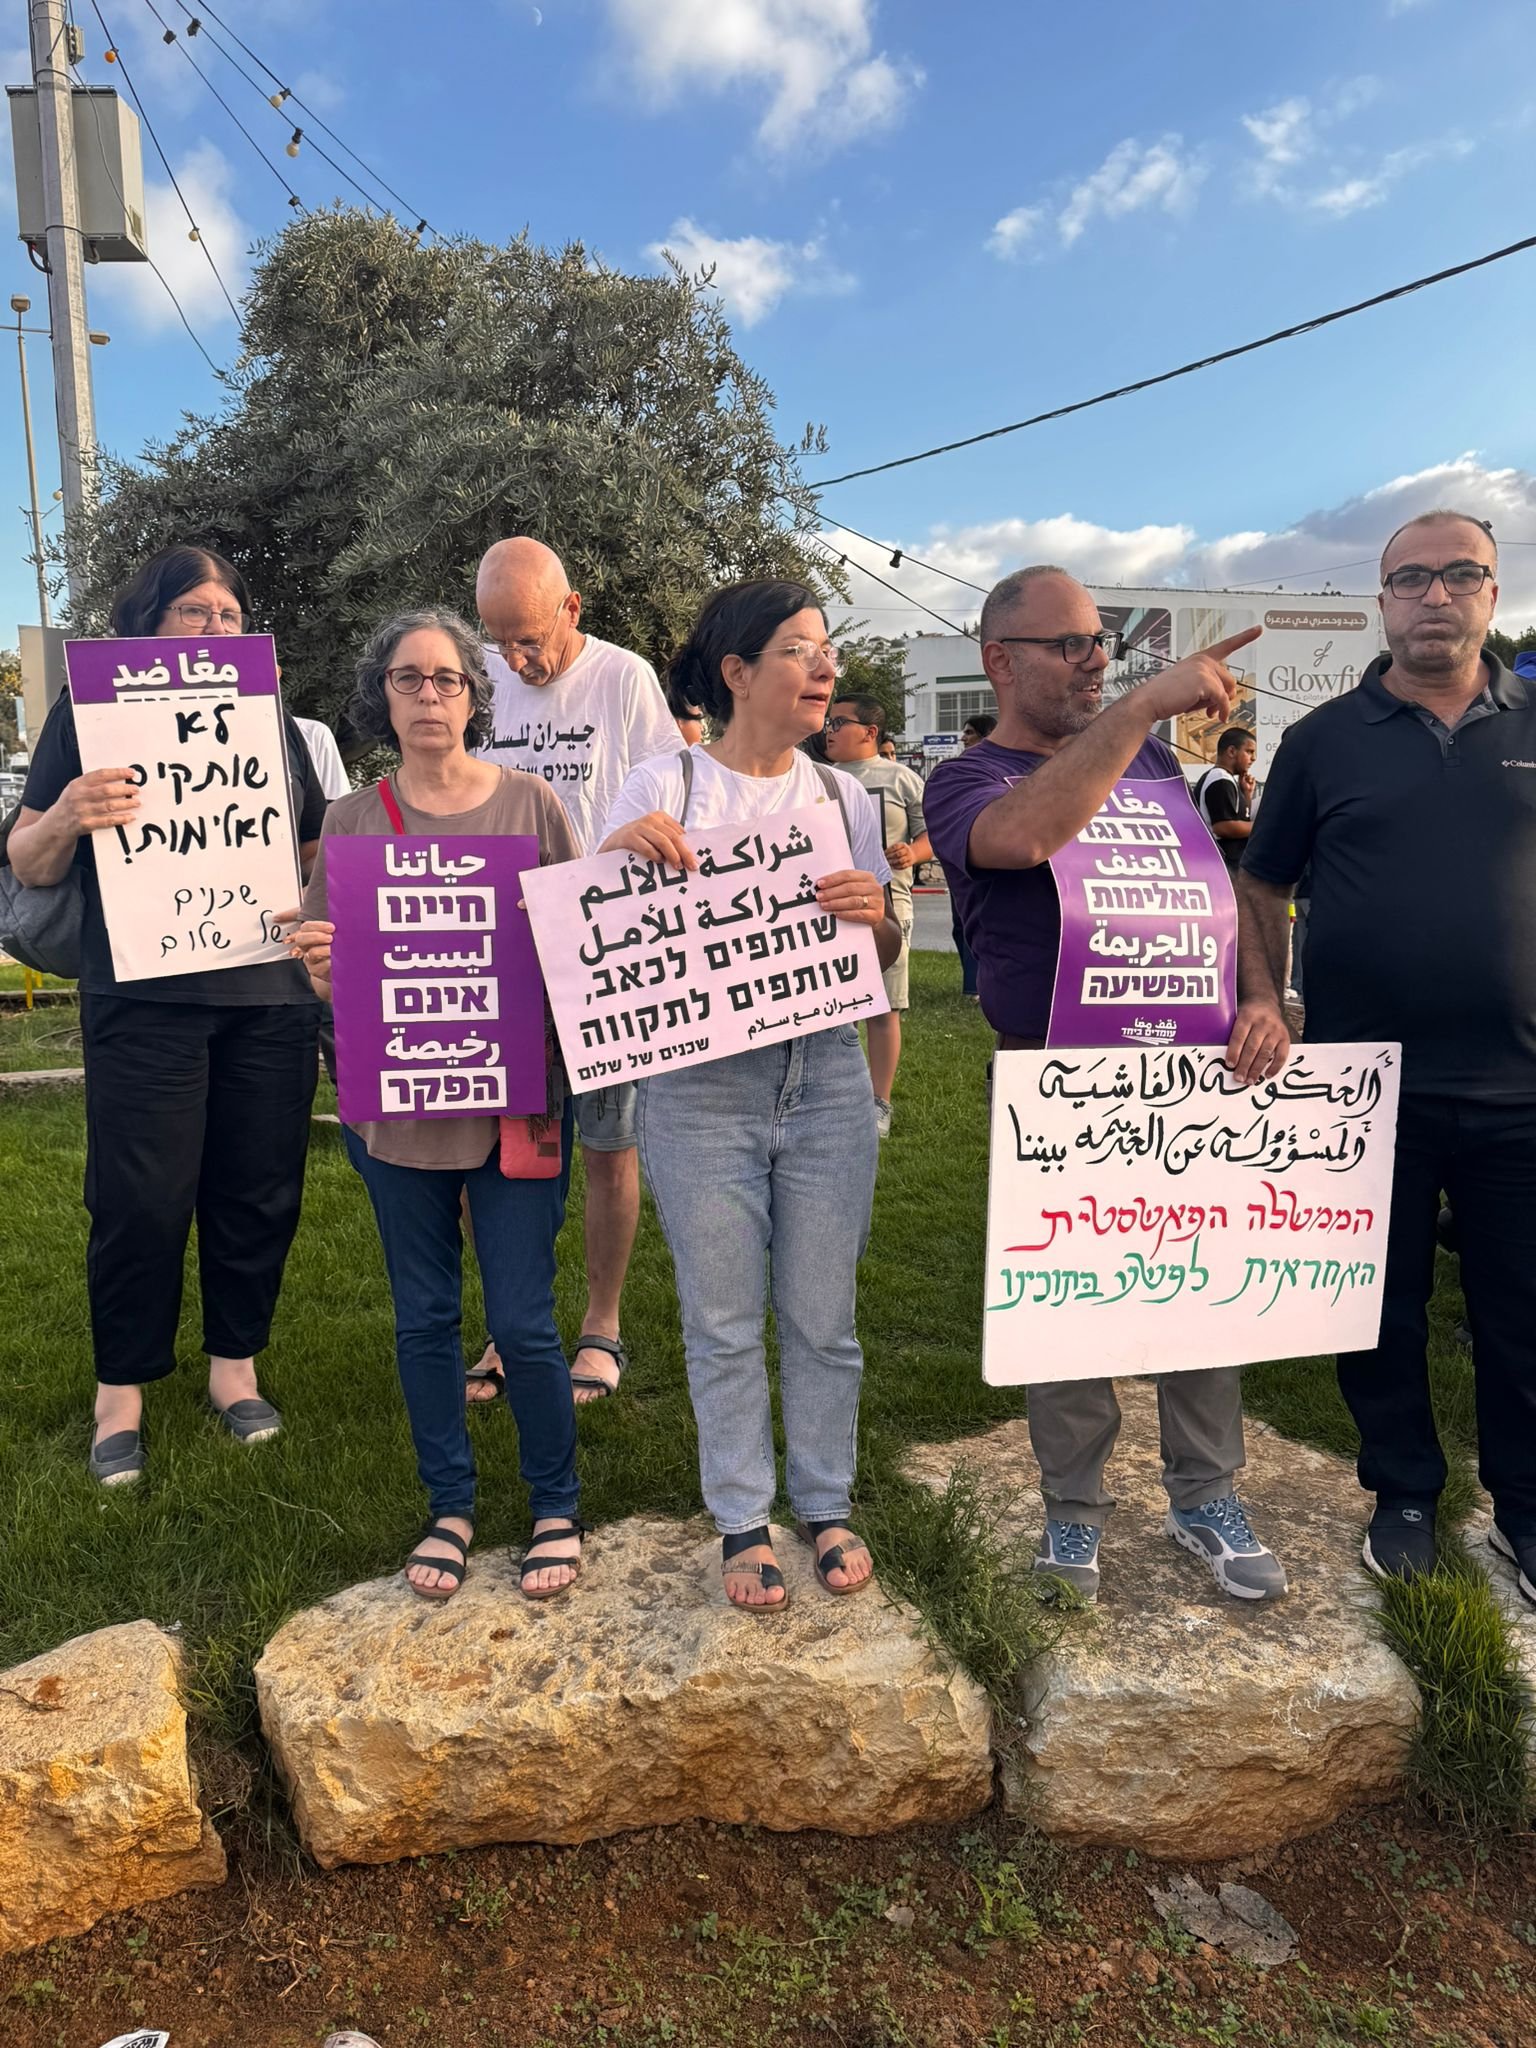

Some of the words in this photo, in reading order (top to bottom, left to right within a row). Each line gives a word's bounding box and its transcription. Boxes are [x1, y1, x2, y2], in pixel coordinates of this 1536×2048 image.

[1292, 616, 1308, 628] في
[1342, 618, 1367, 626] جديد
[112, 658, 170, 687] ضد
[175, 702, 236, 745] לא
[532, 719, 596, 753] جيران
[542, 762, 594, 783] שכנים
[114, 802, 281, 865] לאלימות!
[696, 824, 815, 879] شراكة
[1121, 823, 1172, 842] יחד
[384, 842, 487, 884] حياتنا
[1094, 847, 1188, 878] العنف
[174, 884, 258, 917] שכנים
[386, 894, 487, 924] חיינו
[695, 872, 821, 932] شراكة
[1091, 882, 1208, 911] האלימות
[160, 920, 231, 958] שלום
[578, 902, 687, 967] للأمل
[703, 912, 838, 971] שותפים
[1088, 918, 1219, 967] والجريمة
[382, 934, 493, 975] ليست
[585, 946, 688, 1006] לכאב,
[726, 953, 860, 1012] שותפים
[1088, 974, 1214, 999] והפשיעה
[393, 984, 491, 1015] אינם
[579, 987, 711, 1049] לתקווה
[793, 1007, 821, 1026] مع
[823, 992, 875, 1017] جيران
[384, 1026, 501, 1068] رخيصة
[747, 1015, 790, 1041] سلام
[1121, 1027, 1143, 1036] ביחד
[1145, 1029, 1177, 1038] עומדים
[626, 1050, 654, 1069] של
[658, 1036, 710, 1062] שכנים
[576, 1055, 623, 1082] שלום
[387, 1073, 500, 1111] הפקר
[1007, 1103, 1067, 1173] بيننا
[1246, 1180, 1375, 1236] הממשלה
[1003, 1195, 1229, 1260] הפאשסטית
[1091, 1233, 1210, 1306] לפשע
[1208, 1257, 1377, 1317] האחראית
[985, 1268, 1105, 1312] בתוכינו
